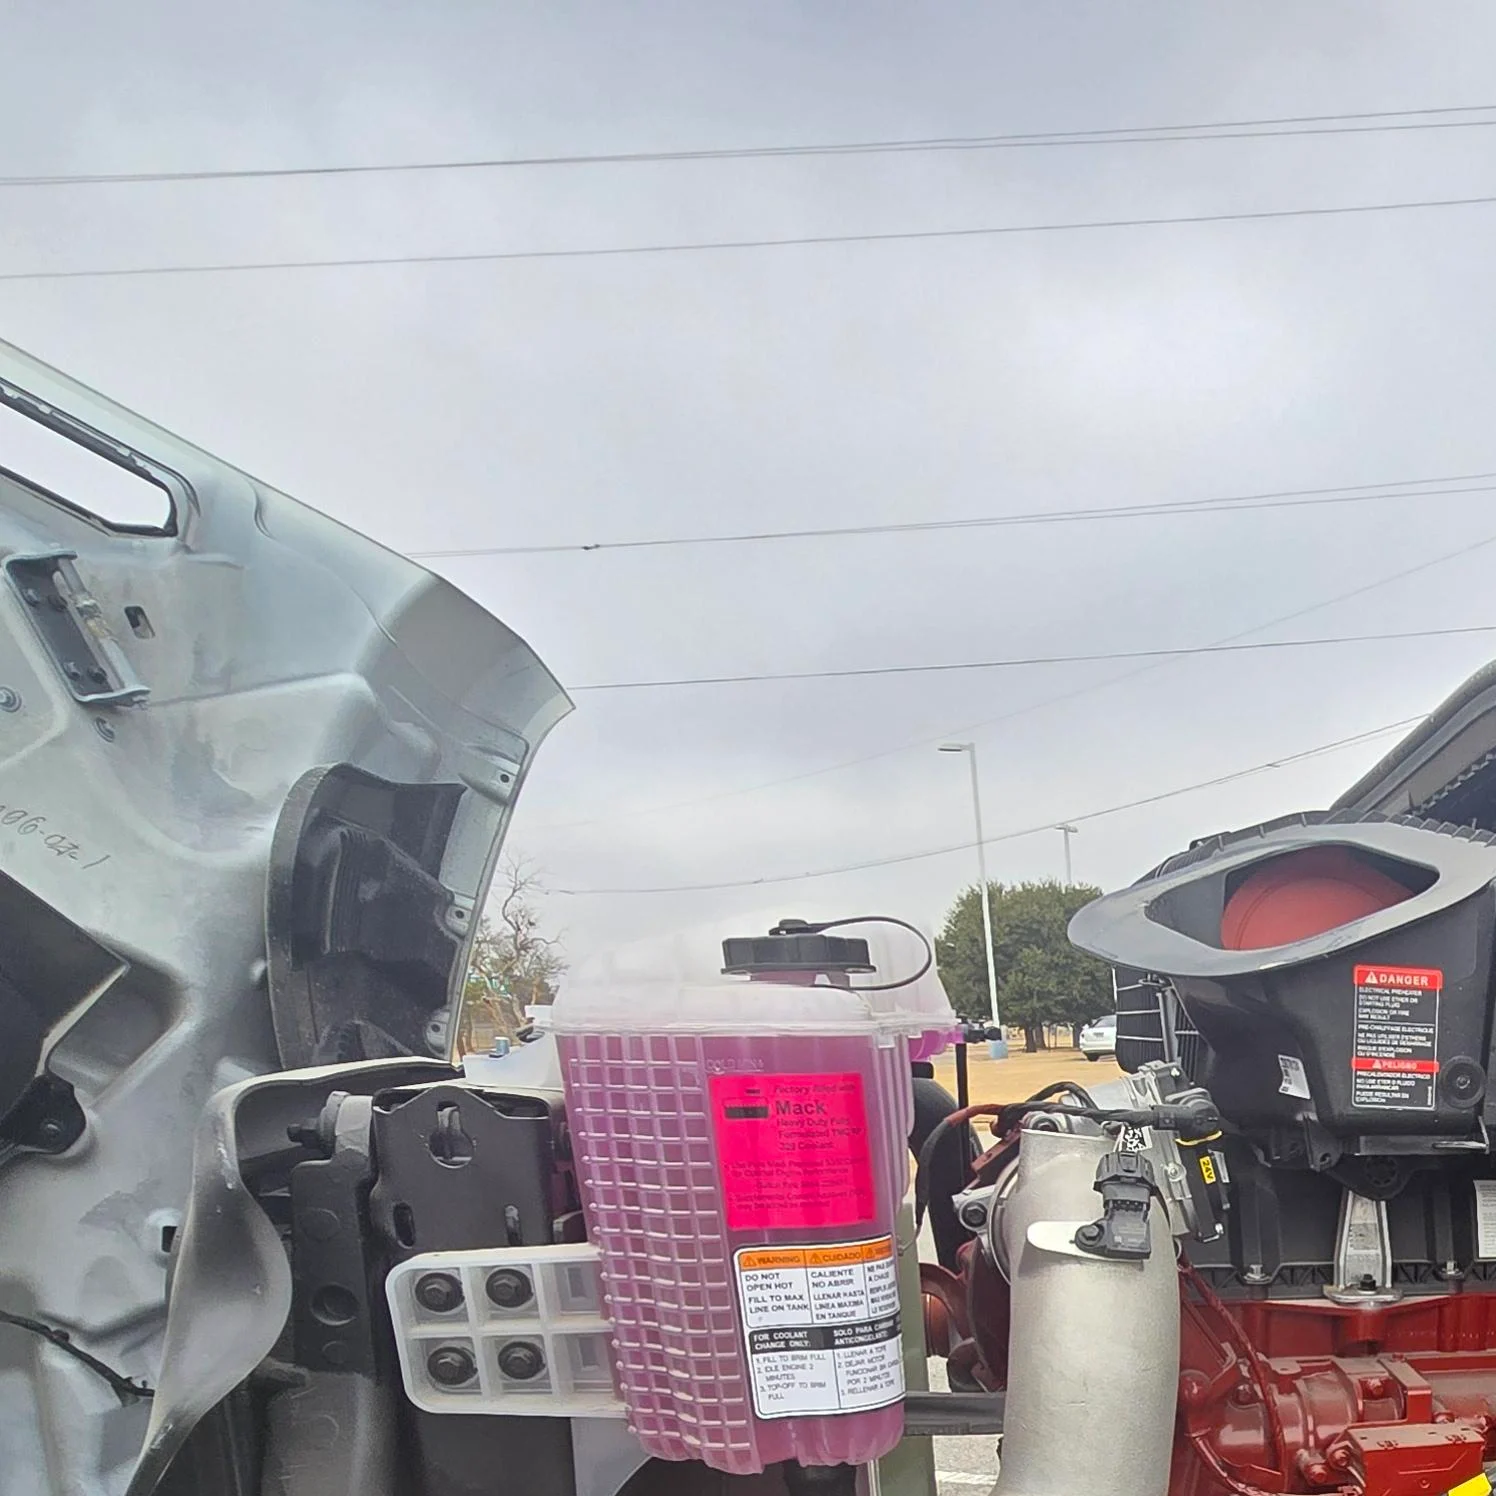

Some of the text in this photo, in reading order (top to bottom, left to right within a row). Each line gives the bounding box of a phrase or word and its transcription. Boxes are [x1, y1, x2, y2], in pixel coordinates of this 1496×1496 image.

[1380, 974, 1429, 985] DANGER
[1383, 1061, 1416, 1069] PELIGRO
[774, 1085, 810, 1094] Factory
[776, 1100, 827, 1115] Mack
[777, 1119, 804, 1128] Heavy
[807, 1118, 828, 1127] Duty
[1202, 1160, 1214, 1180] 24V
[757, 1256, 800, 1264] WARNING
[823, 1253, 860, 1262] CUIDADO
[811, 1269, 854, 1278] CALIENTE
[828, 1279, 854, 1287] ABRIR
[749, 1296, 766, 1304] FILL
[814, 1292, 841, 1301] LLENAR
[786, 1303, 809, 1311] TANK
[773, 1331, 807, 1339] COOLANT
[834, 1329, 852, 1337] SOLO
[755, 1342, 785, 1350] CHANGE
[766, 1374, 795, 1382] MINUTES
